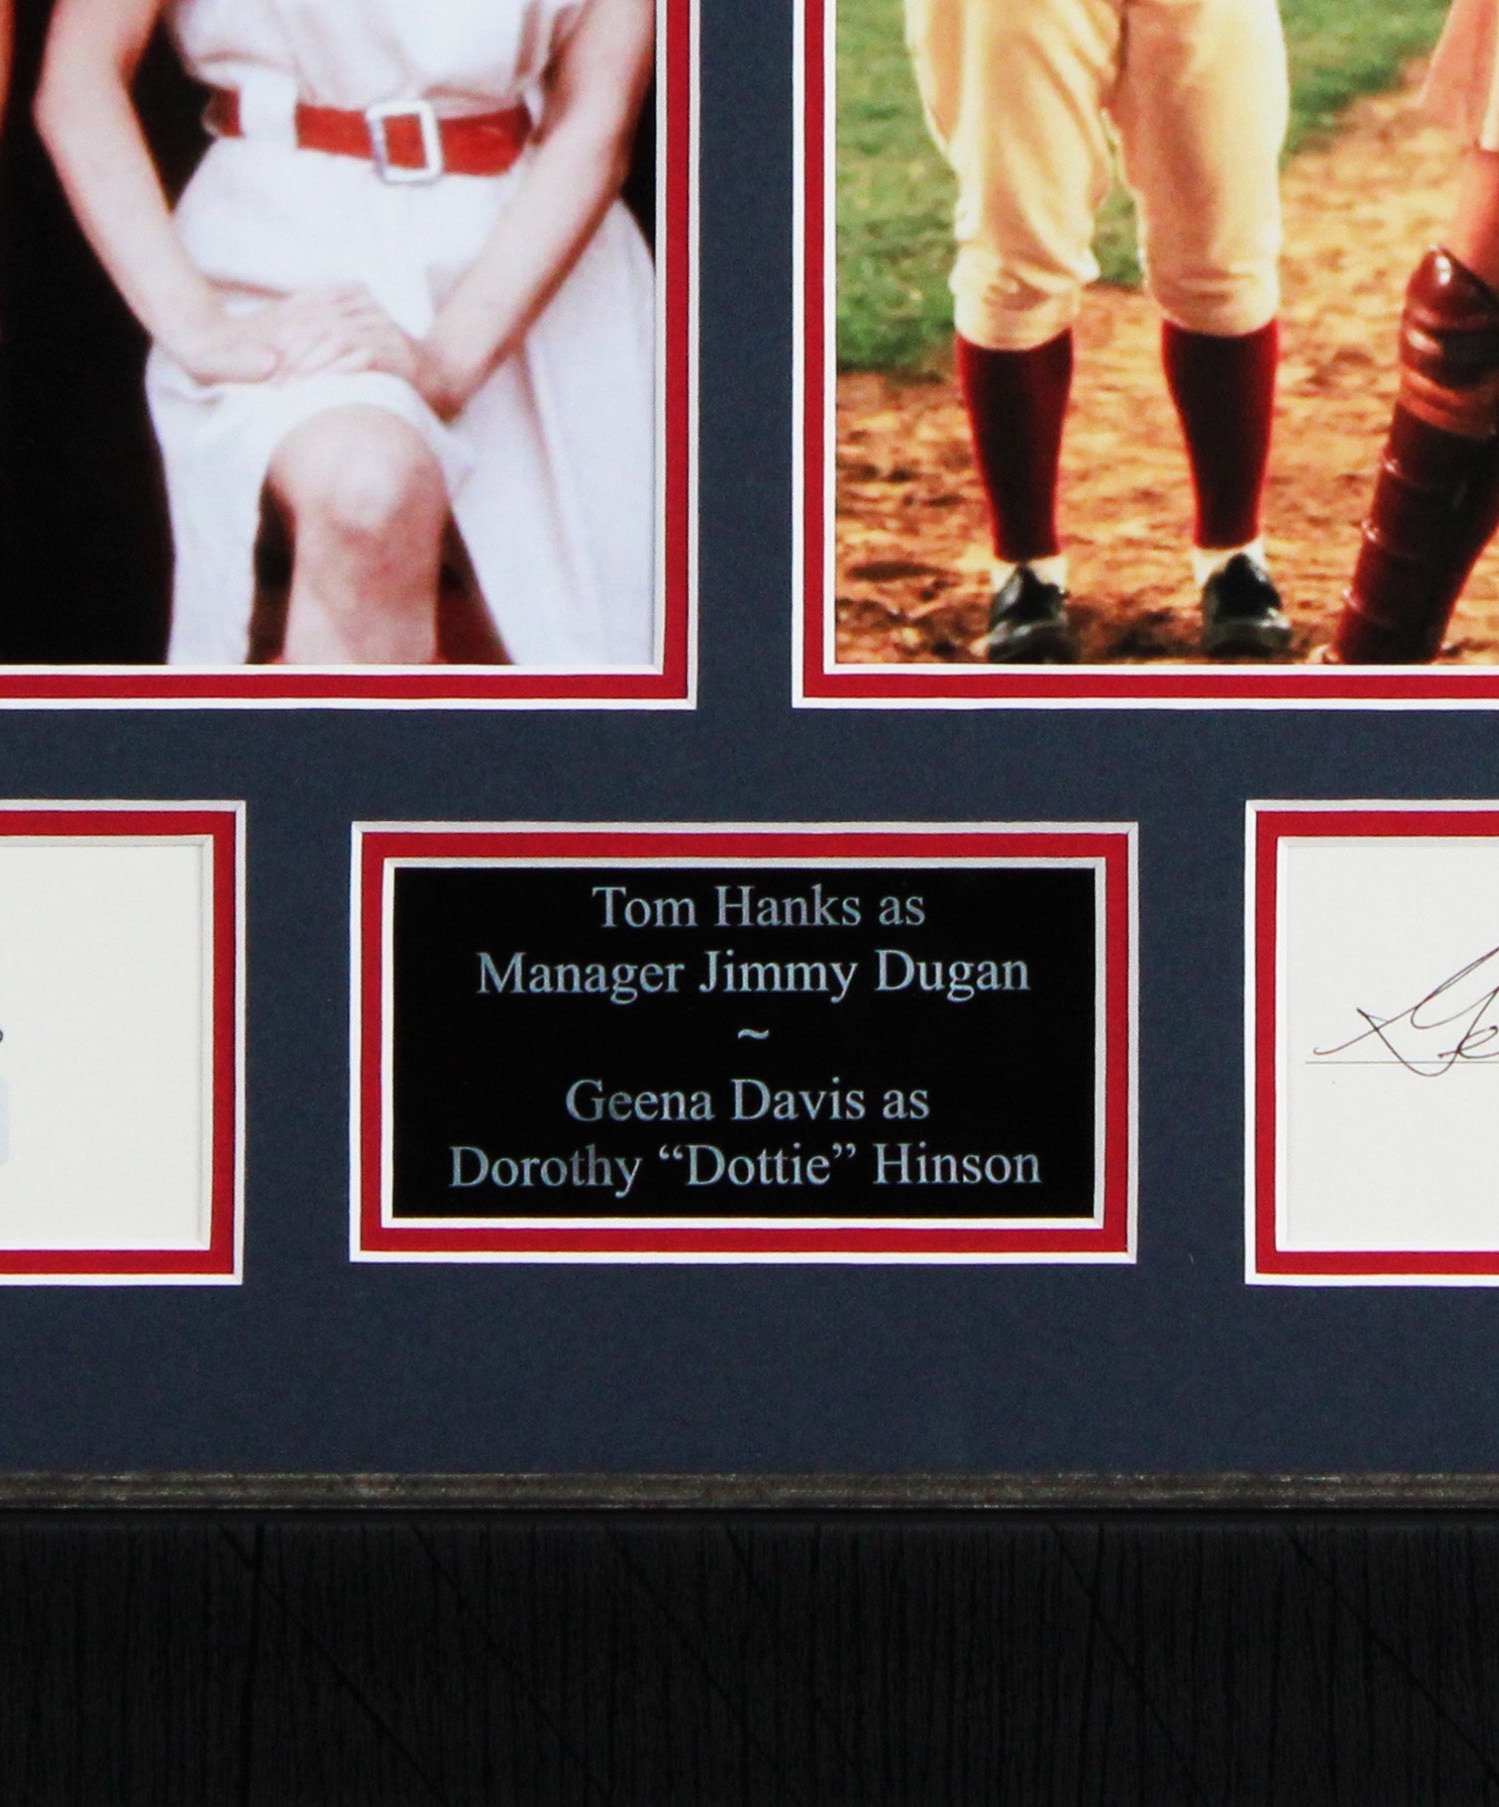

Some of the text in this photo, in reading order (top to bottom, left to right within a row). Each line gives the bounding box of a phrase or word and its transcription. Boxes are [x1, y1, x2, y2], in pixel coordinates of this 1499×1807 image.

[591, 883, 926, 928] Tom Hanks as
[477, 949, 1030, 1005] Manager Jimmy Dugan
[565, 1076, 930, 1122] Geena Davis as
[449, 1144, 642, 1199] Dorothy
[873, 1140, 1042, 1186] Hinson
